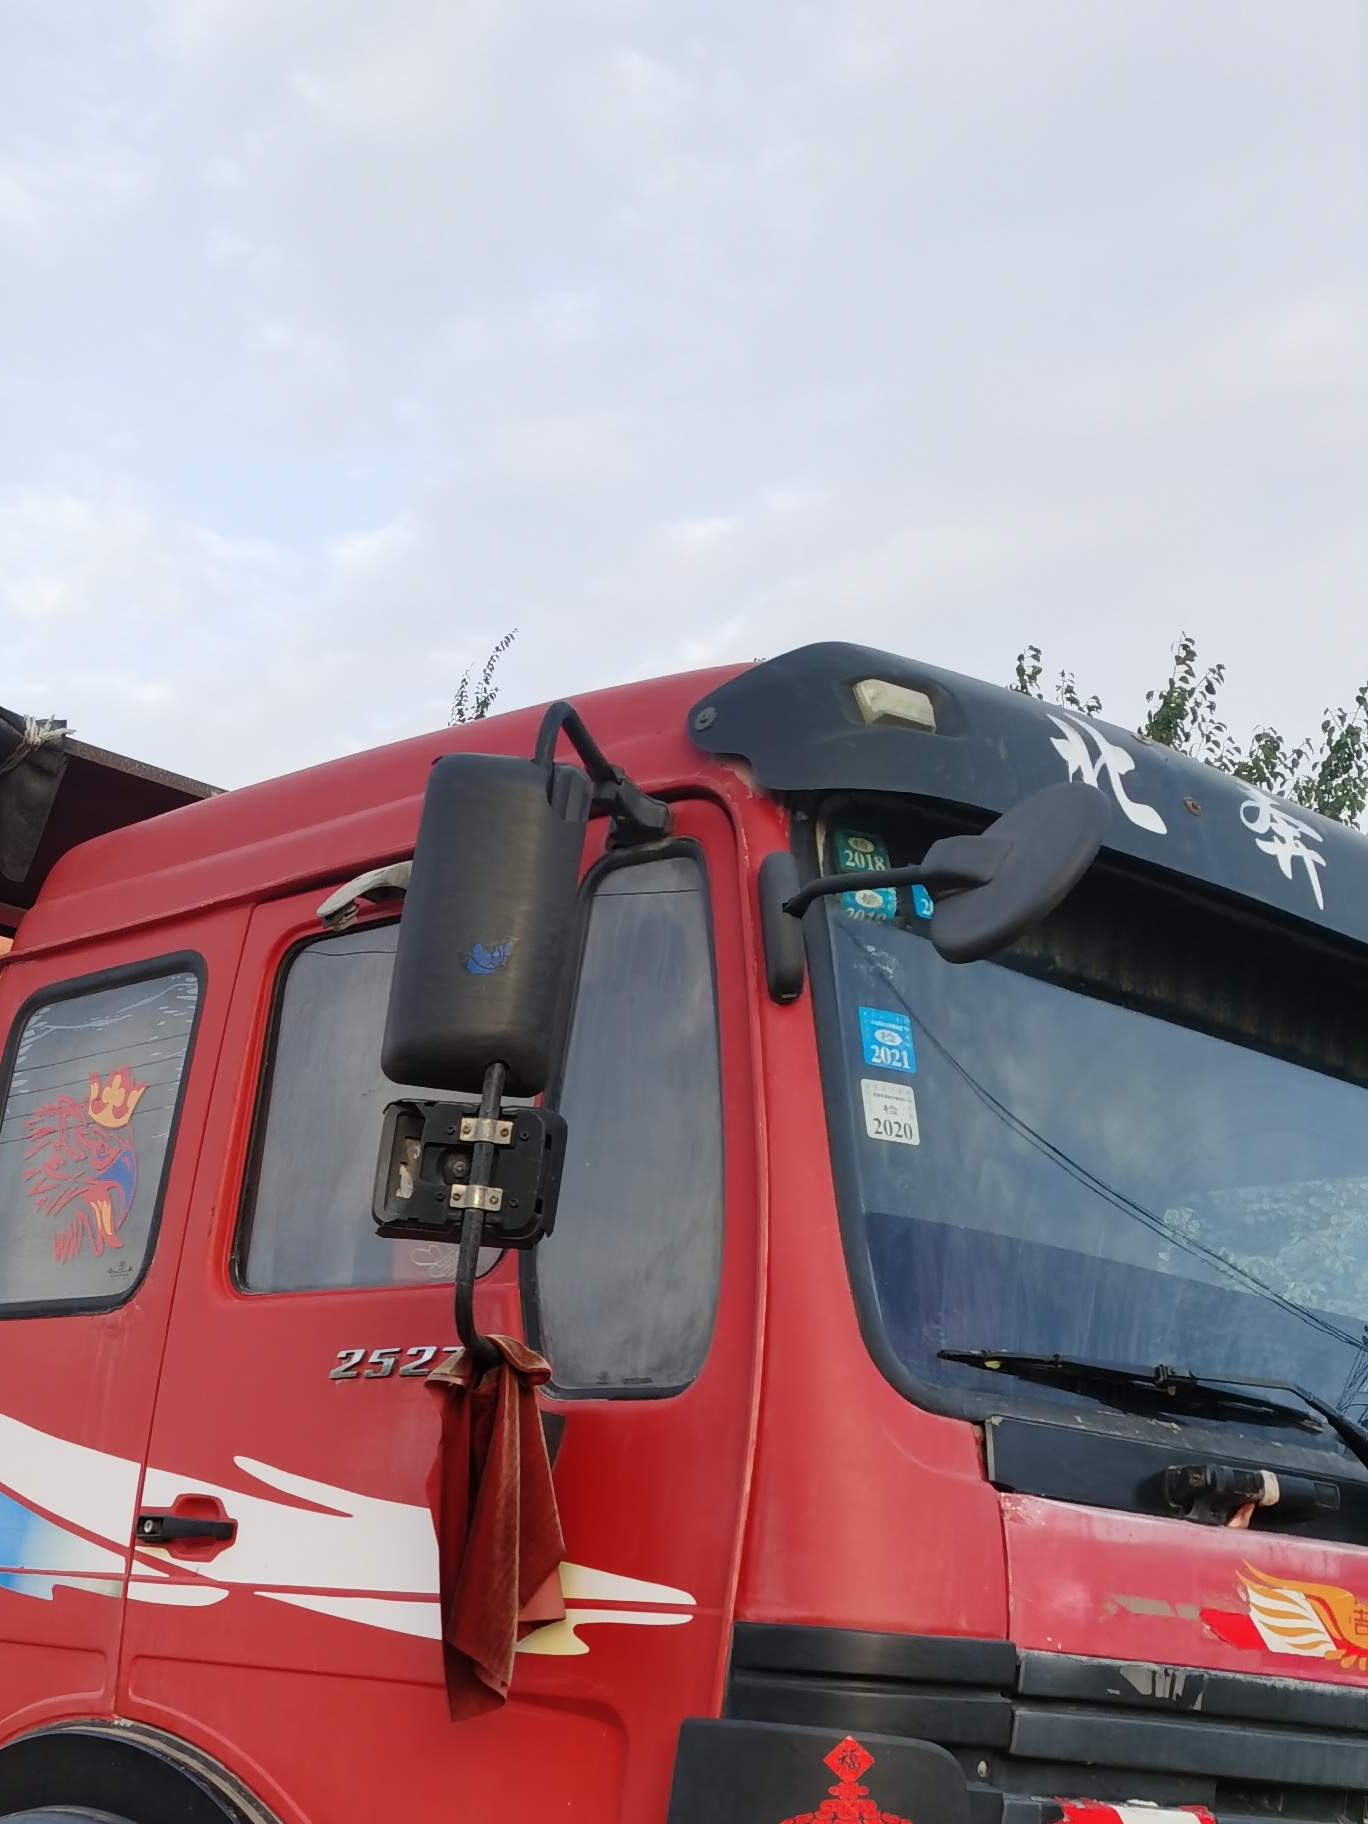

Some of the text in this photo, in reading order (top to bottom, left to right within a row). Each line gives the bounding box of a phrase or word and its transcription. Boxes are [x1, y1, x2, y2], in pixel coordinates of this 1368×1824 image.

[843, 849, 886, 872] 2018
[870, 1044, 912, 1069] 2021
[872, 1117, 913, 1141] 2020
